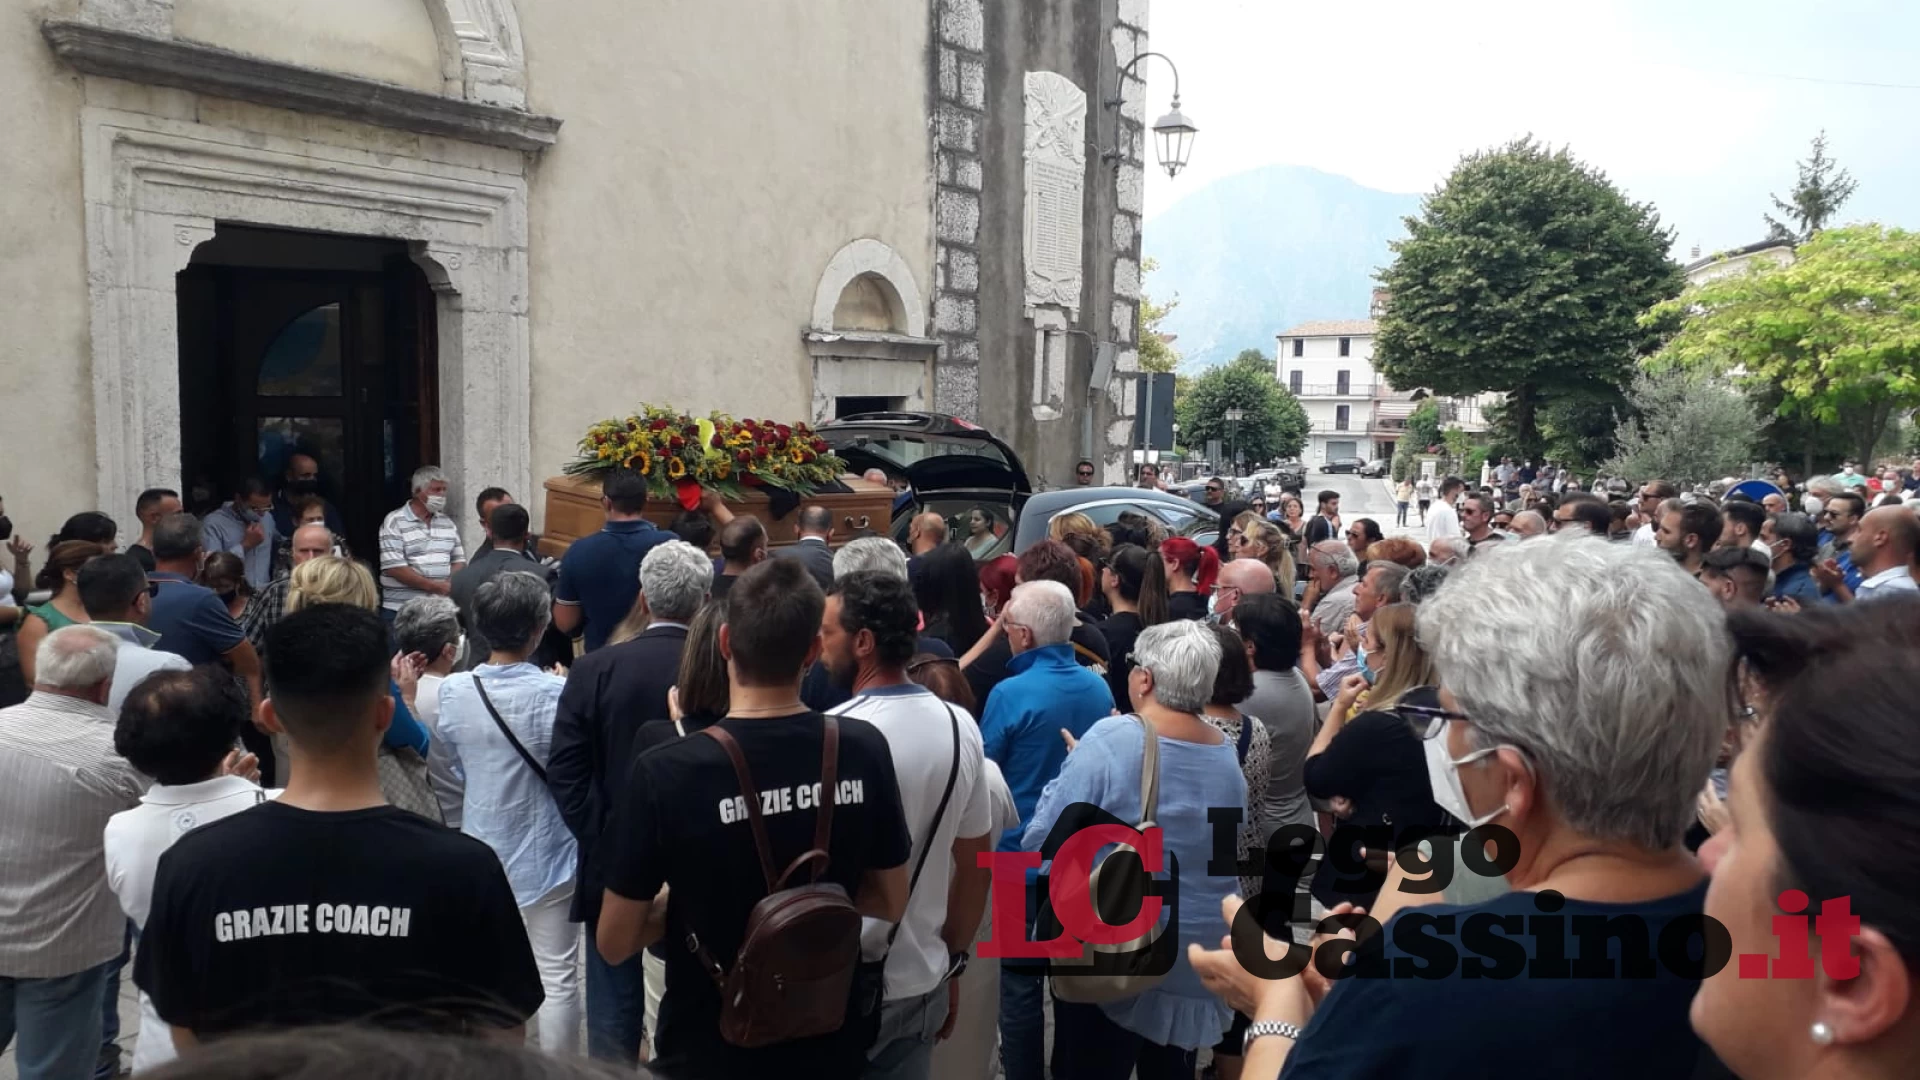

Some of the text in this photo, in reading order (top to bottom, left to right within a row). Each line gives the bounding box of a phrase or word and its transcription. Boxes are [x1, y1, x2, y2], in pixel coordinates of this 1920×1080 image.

[718, 786, 793, 825] GRZIE
[215, 902, 411, 942] GRAZIE COACH
